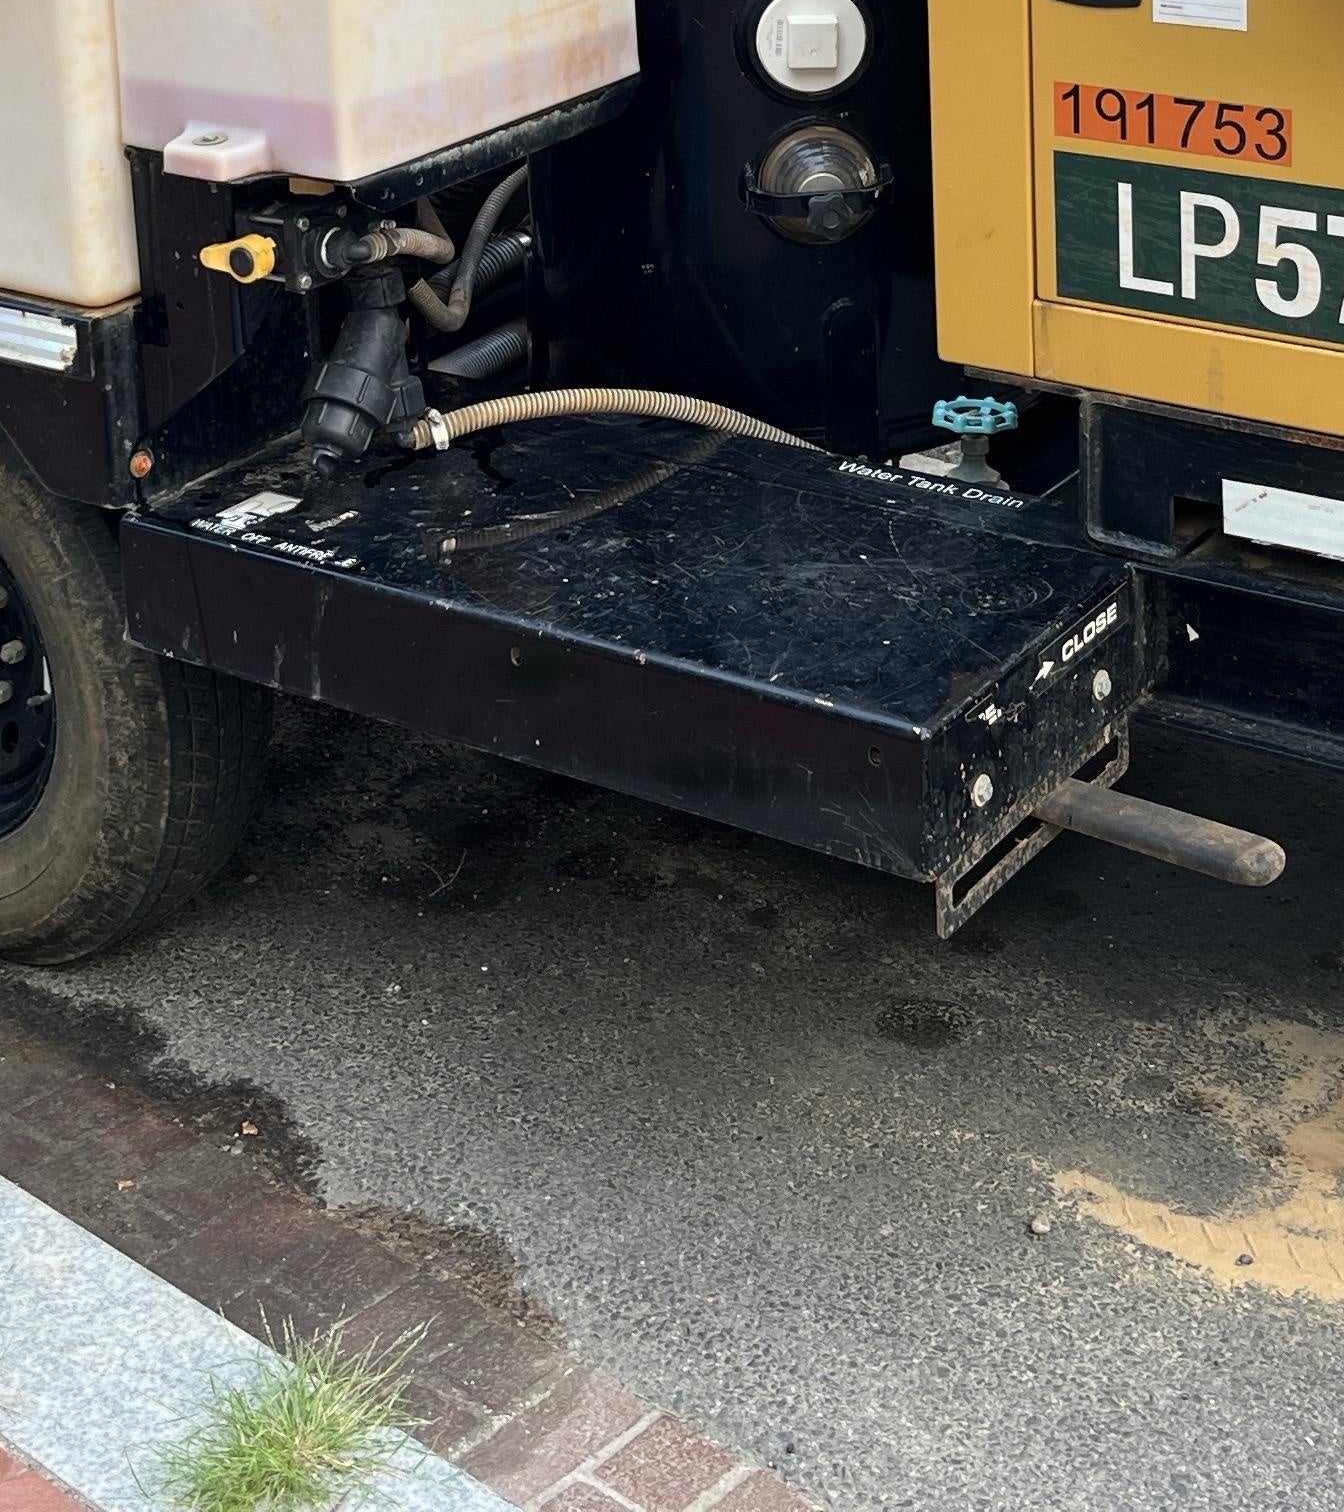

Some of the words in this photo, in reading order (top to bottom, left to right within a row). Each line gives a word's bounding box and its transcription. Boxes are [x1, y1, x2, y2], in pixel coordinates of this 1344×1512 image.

[1060, 83, 1289, 161] 191753
[838, 460, 904, 482] Water
[907, 475, 958, 495] Tank
[961, 487, 1025, 509] Drain
[241, 533, 272, 544] OFF
[1061, 602, 1118, 662] CLOSE
